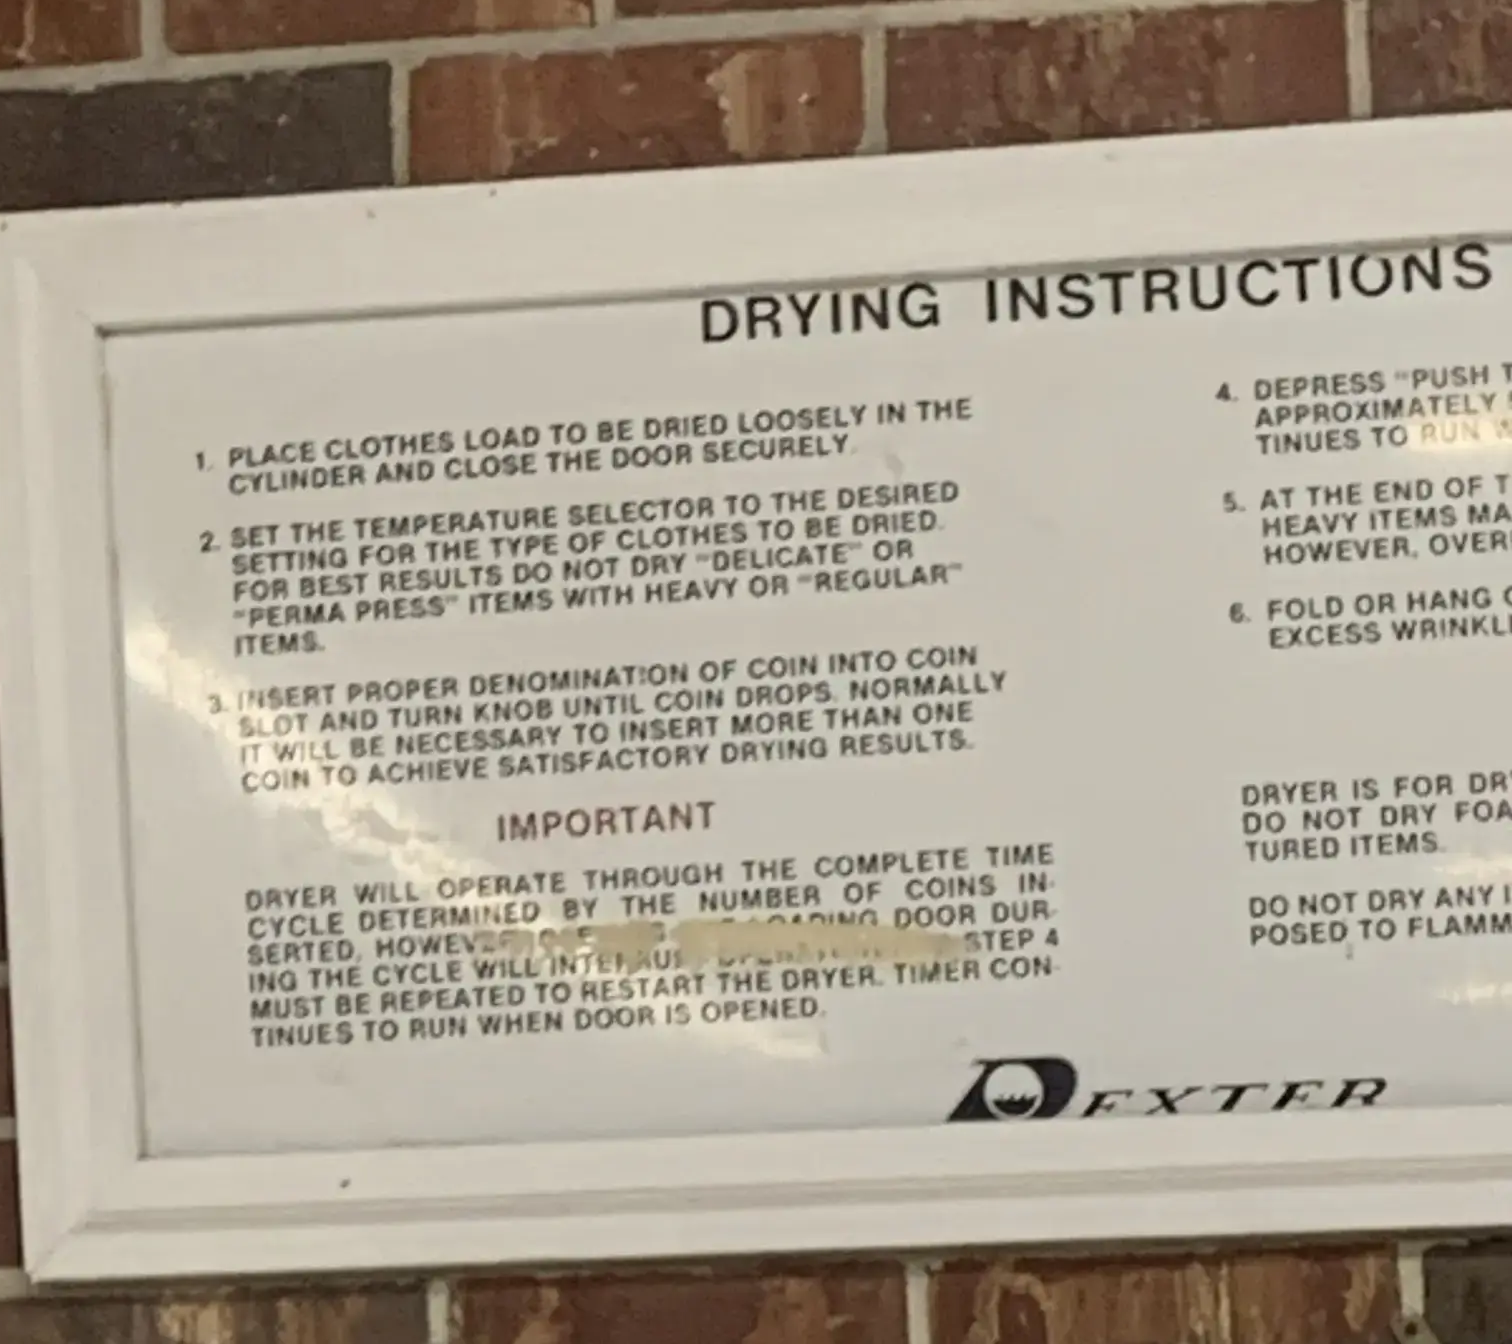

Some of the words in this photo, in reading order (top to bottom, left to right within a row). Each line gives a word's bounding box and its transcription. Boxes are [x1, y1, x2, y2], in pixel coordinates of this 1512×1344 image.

[701, 281, 940, 344] DRYING
[986, 242, 1493, 323] INSTRUCTIONS
[1253, 370, 1386, 401] DEPRESS
[1394, 363, 1489, 392] "PUSH
[1254, 391, 1496, 428] APPROXIMATELY
[228, 440, 315, 469] PLACE
[323, 430, 455, 461] CLOTHES
[463, 425, 540, 452] LOAD
[548, 422, 587, 446] TO
[597, 419, 633, 443] BE
[643, 413, 728, 441] DRIED
[737, 404, 867, 435] LOOSELY
[877, 402, 906, 424] IN
[915, 397, 972, 422] THE
[1255, 427, 1361, 456] TINUES
[1369, 423, 1408, 448] TO
[1421, 419, 1479, 445] RUN
[228, 463, 366, 495] CYLINDER
[375, 458, 435, 484] AND
[443, 451, 537, 480] CLOSE
[545, 448, 601, 474] THE
[611, 442, 692, 470] DOOR
[1260, 487, 1295, 510] AT
[1305, 483, 1362, 509] THE
[1373, 478, 1434, 504] END
[1443, 475, 1482, 499] OF
[231, 523, 280, 549] SET
[289, 519, 345, 544] THE
[353, 505, 557, 540] TEMPERATURE
[567, 495, 714, 527] SELECTOR
[723, 492, 762, 517] TO
[769, 488, 827, 514] THE
[836, 480, 959, 510] DESIRED
[1262, 511, 1358, 539] HEAVY
[1369, 504, 1458, 532] ITEMS
[231, 546, 348, 576] SETTING
[358, 541, 416, 568] FOR
[424, 538, 480, 563] THE
[489, 533, 558, 559] TYPE
[567, 529, 606, 555] OF
[615, 521, 748, 551] CLOTHES
[756, 518, 795, 542] TO
[804, 515, 840, 540] BE
[233, 577, 289, 603] FOR
[299, 572, 369, 599] BEST
[378, 563, 503, 593] RESULTS
[512, 560, 553, 585] DO
[562, 556, 620, 582] NOT
[630, 552, 687, 577] DRY
[695, 541, 862, 574] "DELICATE"
[872, 538, 914, 563] OR
[233, 601, 346, 629] "PERMA
[355, 594, 459, 622] PRESS"
[468, 588, 554, 615] ITEMS
[562, 583, 634, 608] WITH
[644, 576, 738, 604] HEAVY
[748, 573, 789, 599] OR
[797, 562, 962, 594] "REGULAR"
[1267, 594, 1344, 622] FOLD
[1353, 592, 1396, 617] OR
[1406, 586, 1492, 613] HANG
[1268, 620, 1382, 649] EXCESS
[237, 683, 335, 712] INSERT
[346, 676, 458, 704] PROPER
[469, 662, 688, 697] DENOMINATION
[698, 659, 737, 684] OF
[746, 654, 818, 681] COIN
[828, 649, 897, 675] INTO
[905, 645, 977, 671] COIN
[238, 711, 308, 739] SLOT
[319, 708, 378, 733] AND
[386, 703, 462, 729] TURN
[473, 697, 553, 724] KNOB
[562, 692, 645, 719] UNTIL
[653, 687, 724, 713] COIN
[849, 670, 1006, 702] NORMALLY
[240, 743, 261, 765] IT
[271, 738, 339, 764] WILL
[349, 735, 384, 759] BE
[395, 724, 562, 756] NECESSARY
[572, 721, 609, 746] TO
[619, 714, 719, 743] INSERT
[731, 709, 813, 736] MORE
[822, 704, 902, 730] THAN
[912, 700, 973, 725] ONE
[241, 767, 310, 793] COIN
[319, 763, 358, 788] TO
[367, 756, 488, 785] ACHIEVE
[497, 743, 710, 777] SATISFACTORY
[720, 736, 828, 764] DRYING
[1241, 779, 1338, 807] DRYER
[1352, 777, 1380, 802] IS
[1393, 773, 1453, 799] FOR
[497, 800, 715, 842] IMPORTANT
[1241, 809, 1286, 835] DO
[1302, 806, 1362, 832] NOT
[1379, 802, 1437, 827] DRY
[1244, 835, 1340, 863] TURED
[245, 884, 336, 912] DRYER
[353, 881, 420, 905] WILL
[436, 870, 566, 900] OPERATE
[582, 862, 724, 891] THROUGH
[740, 857, 797, 883] THE
[813, 848, 968, 878] COMPLETE
[985, 843, 1054, 868] TIME
[247, 911, 344, 939] CYCLE
[358, 900, 541, 933] DETERMINED
[562, 896, 598, 921] BY
[619, 892, 675, 917] THE
[698, 884, 821, 912] NUMBER
[842, 880, 881, 905] OF
[904, 874, 997, 901] COINS
[893, 903, 976, 930] DOOR
[1248, 894, 1290, 920] DO
[1298, 891, 1358, 916] NOT
[1367, 887, 1425, 913] DRY
[1434, 884, 1494, 909] ANY
[963, 927, 1035, 953] STEP
[1044, 927, 1059, 946] 4
[1250, 919, 1348, 947] POSED
[1357, 916, 1397, 942] TO
[249, 969, 298, 993] ING
[307, 965, 363, 989] THE
[372, 959, 461, 987] CYCLE
[471, 957, 539, 981] WILL
[250, 995, 325, 1020] MUST
[335, 992, 370, 1016] BE
[380, 983, 525, 1013] REPEATED
[533, 980, 572, 1005] TO
[580, 973, 705, 1003] RESTART
[716, 969, 772, 994] THE
[893, 958, 980, 985] TIMER
[250, 1020, 354, 1049] TINUES
[361, 1018, 399, 1042] TO
[409, 1015, 467, 1040] RUN
[476, 1010, 563, 1036] WHEN
[573, 1004, 655, 1031] DOOR
[665, 1002, 691, 1026] IS
